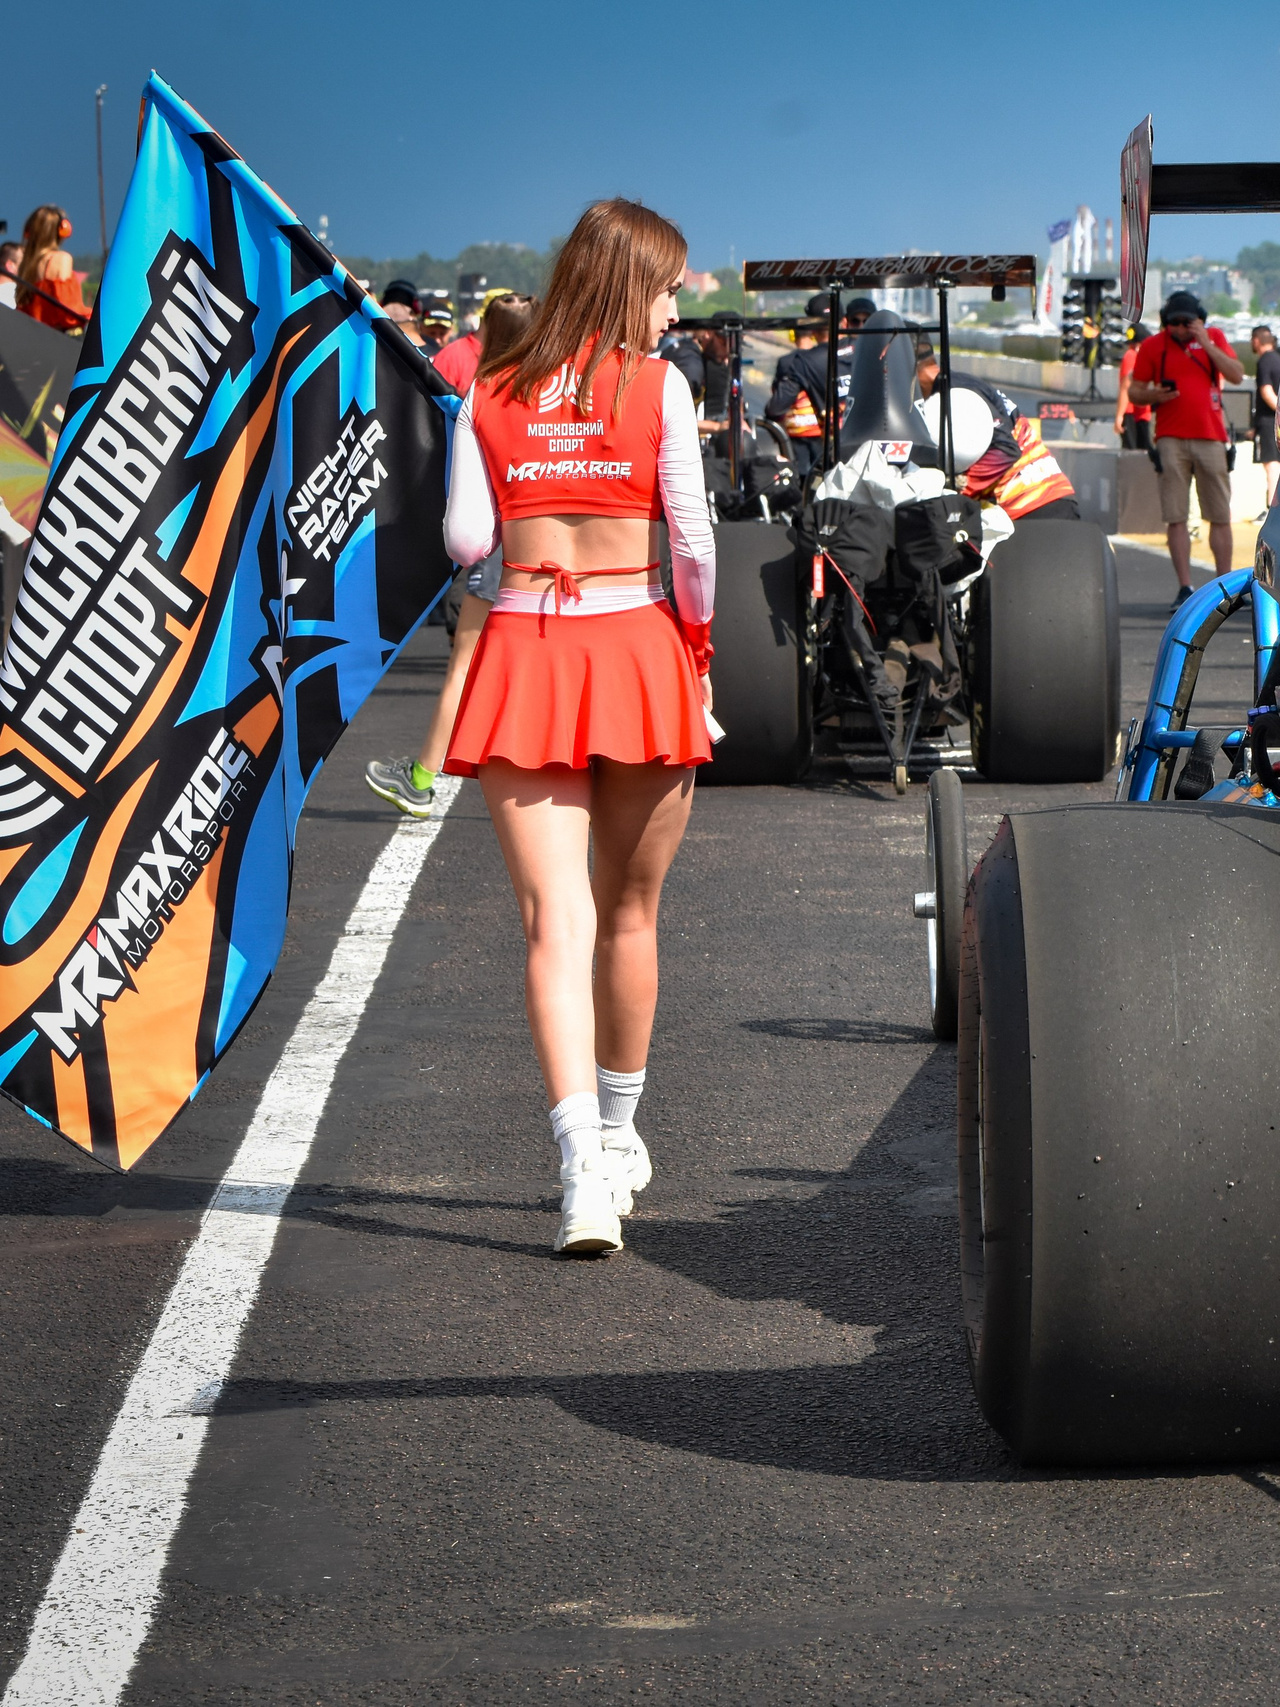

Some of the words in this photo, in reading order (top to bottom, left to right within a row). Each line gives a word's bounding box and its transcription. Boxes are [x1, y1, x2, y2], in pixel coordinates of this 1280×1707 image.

[751, 261, 786, 279] ALL
[936, 256, 1021, 273] LOOSE
[0, 249, 243, 712] МОСКОВСКИЙ
[287, 414, 356, 528] NIGHT
[527, 419, 604, 437] МОСКОВСКИЙ
[544, 473, 631, 481] MOTORSPORT
[549, 438, 585, 452] СПОРТ
[298, 419, 388, 550] RACER
[312, 457, 389, 562] TEAM
[20, 537, 193, 774] СПОРТ
[127, 760, 257, 963] MOTORSPORT
